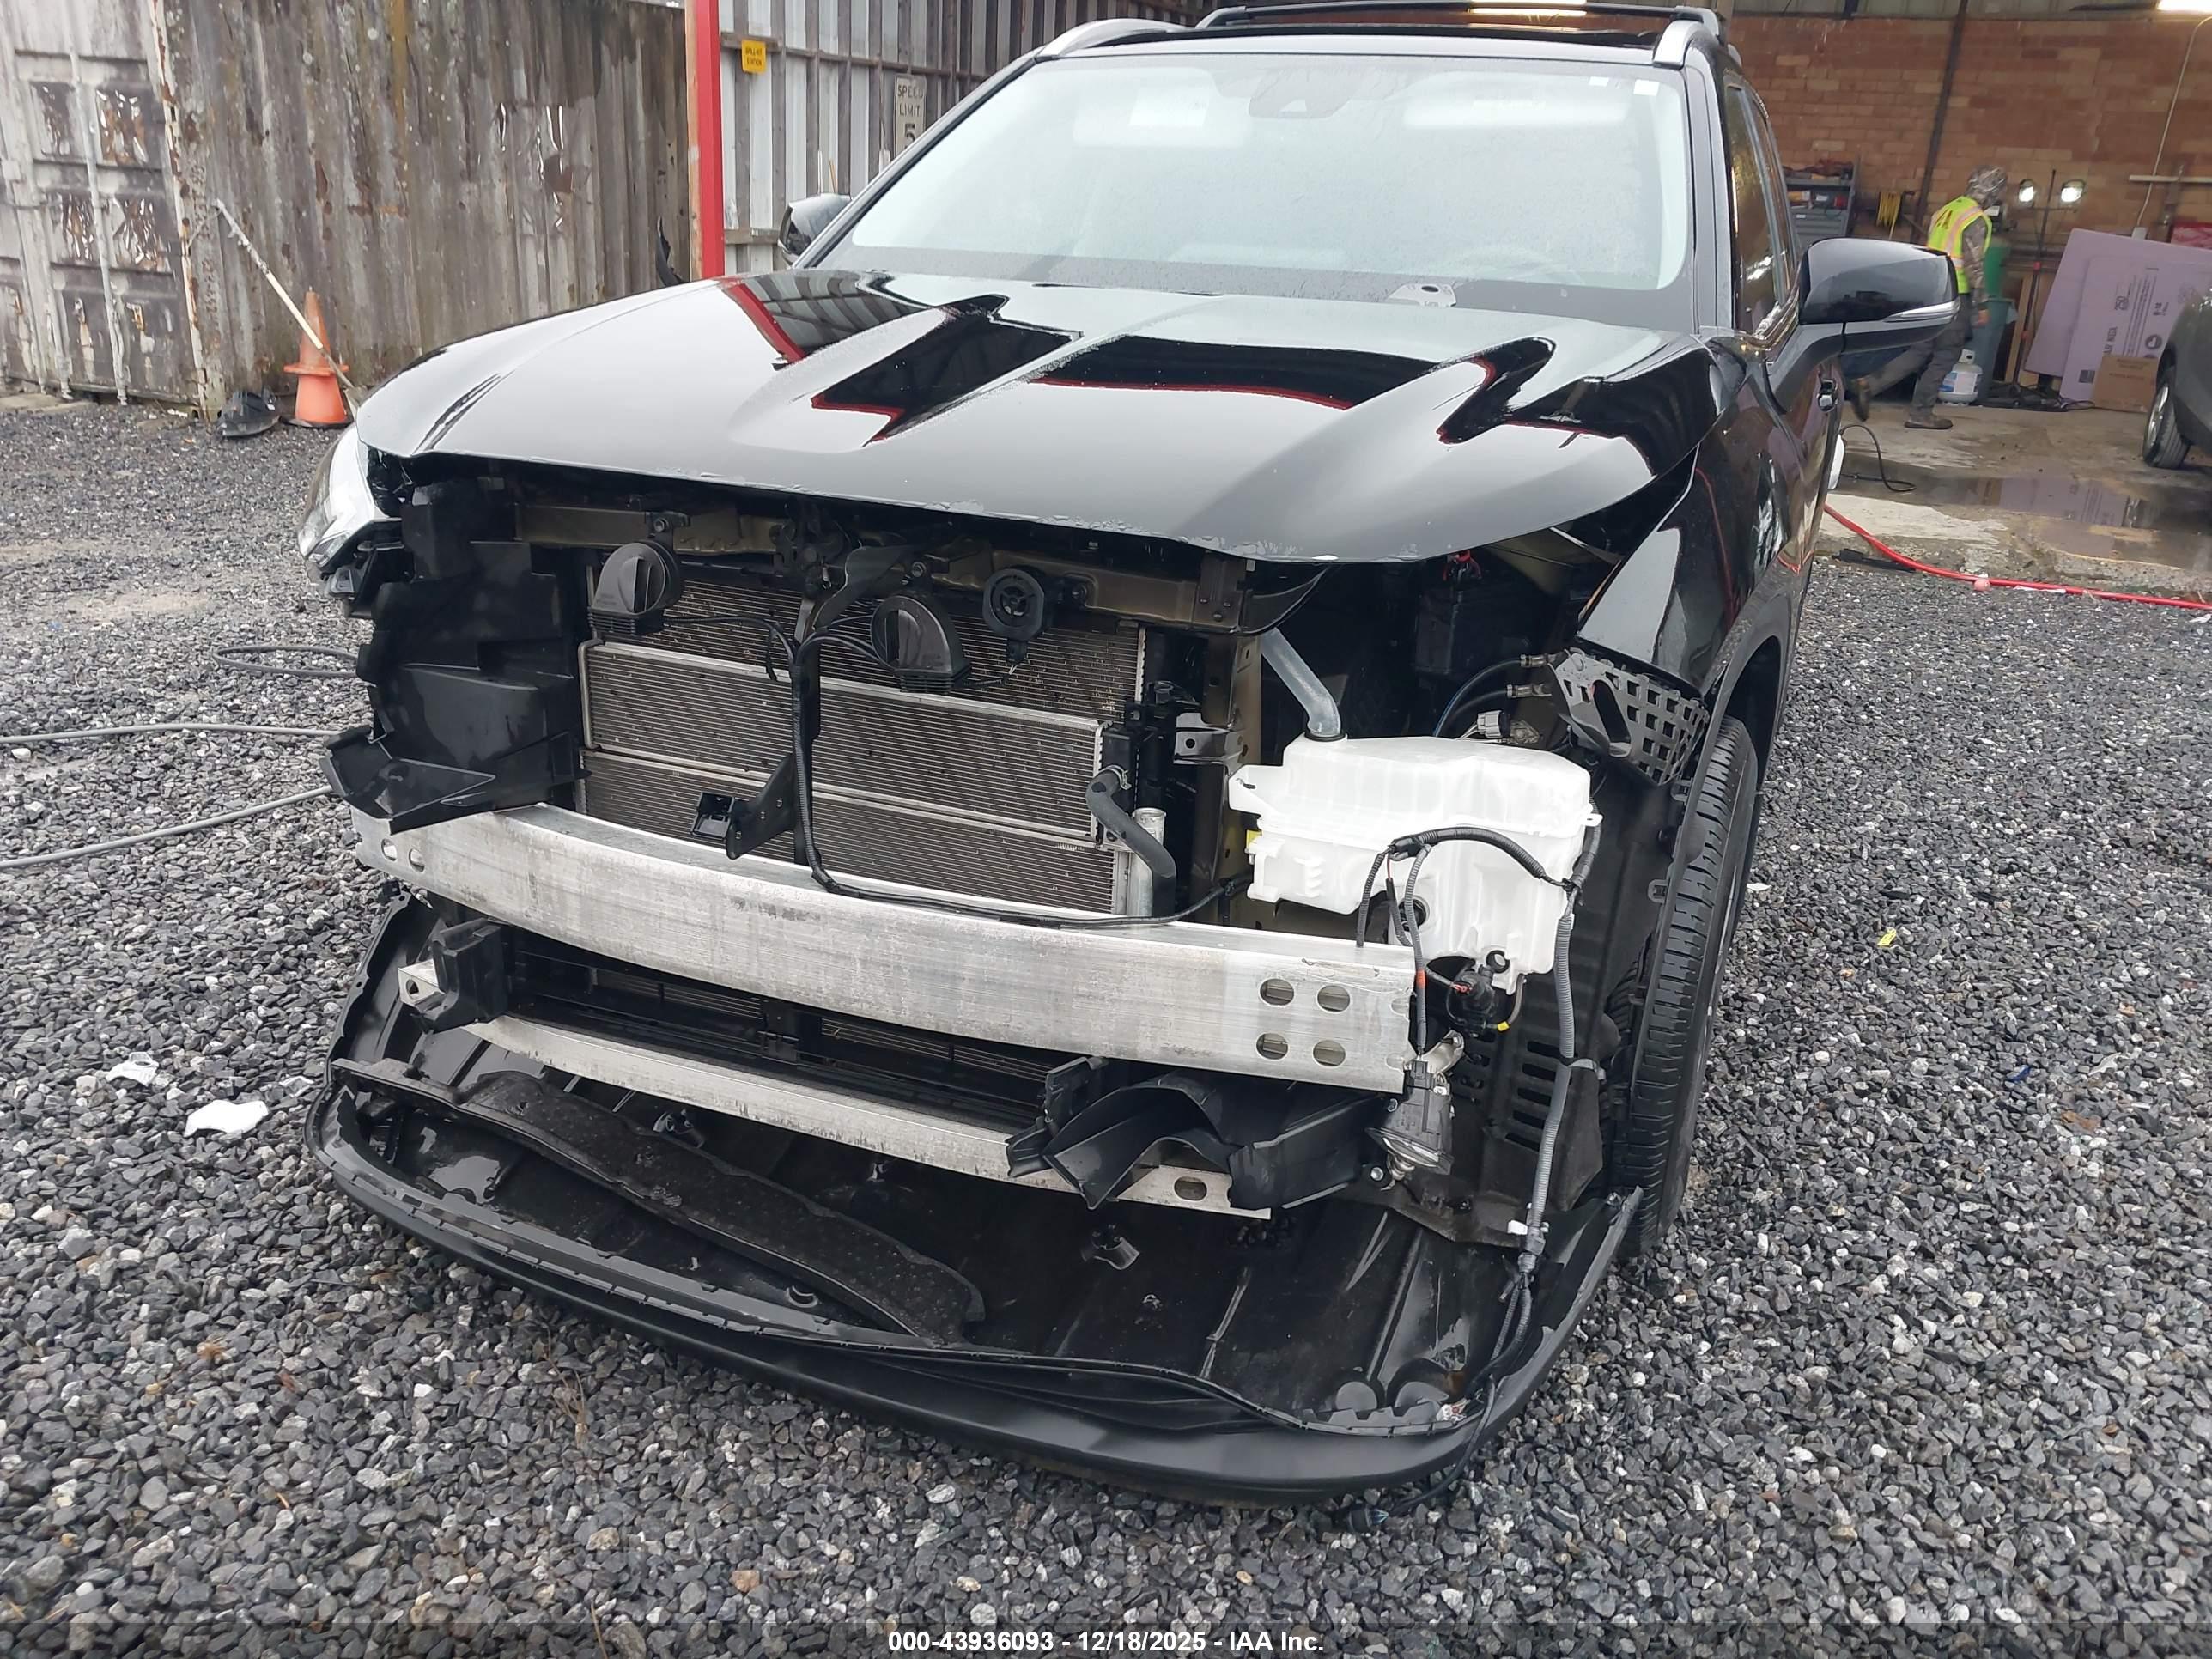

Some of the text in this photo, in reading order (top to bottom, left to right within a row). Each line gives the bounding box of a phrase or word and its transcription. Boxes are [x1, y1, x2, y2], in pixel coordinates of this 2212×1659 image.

[897, 84, 924, 99] SPEED
[899, 103, 921, 117] LIMIT
[904, 123, 915, 149] 5
